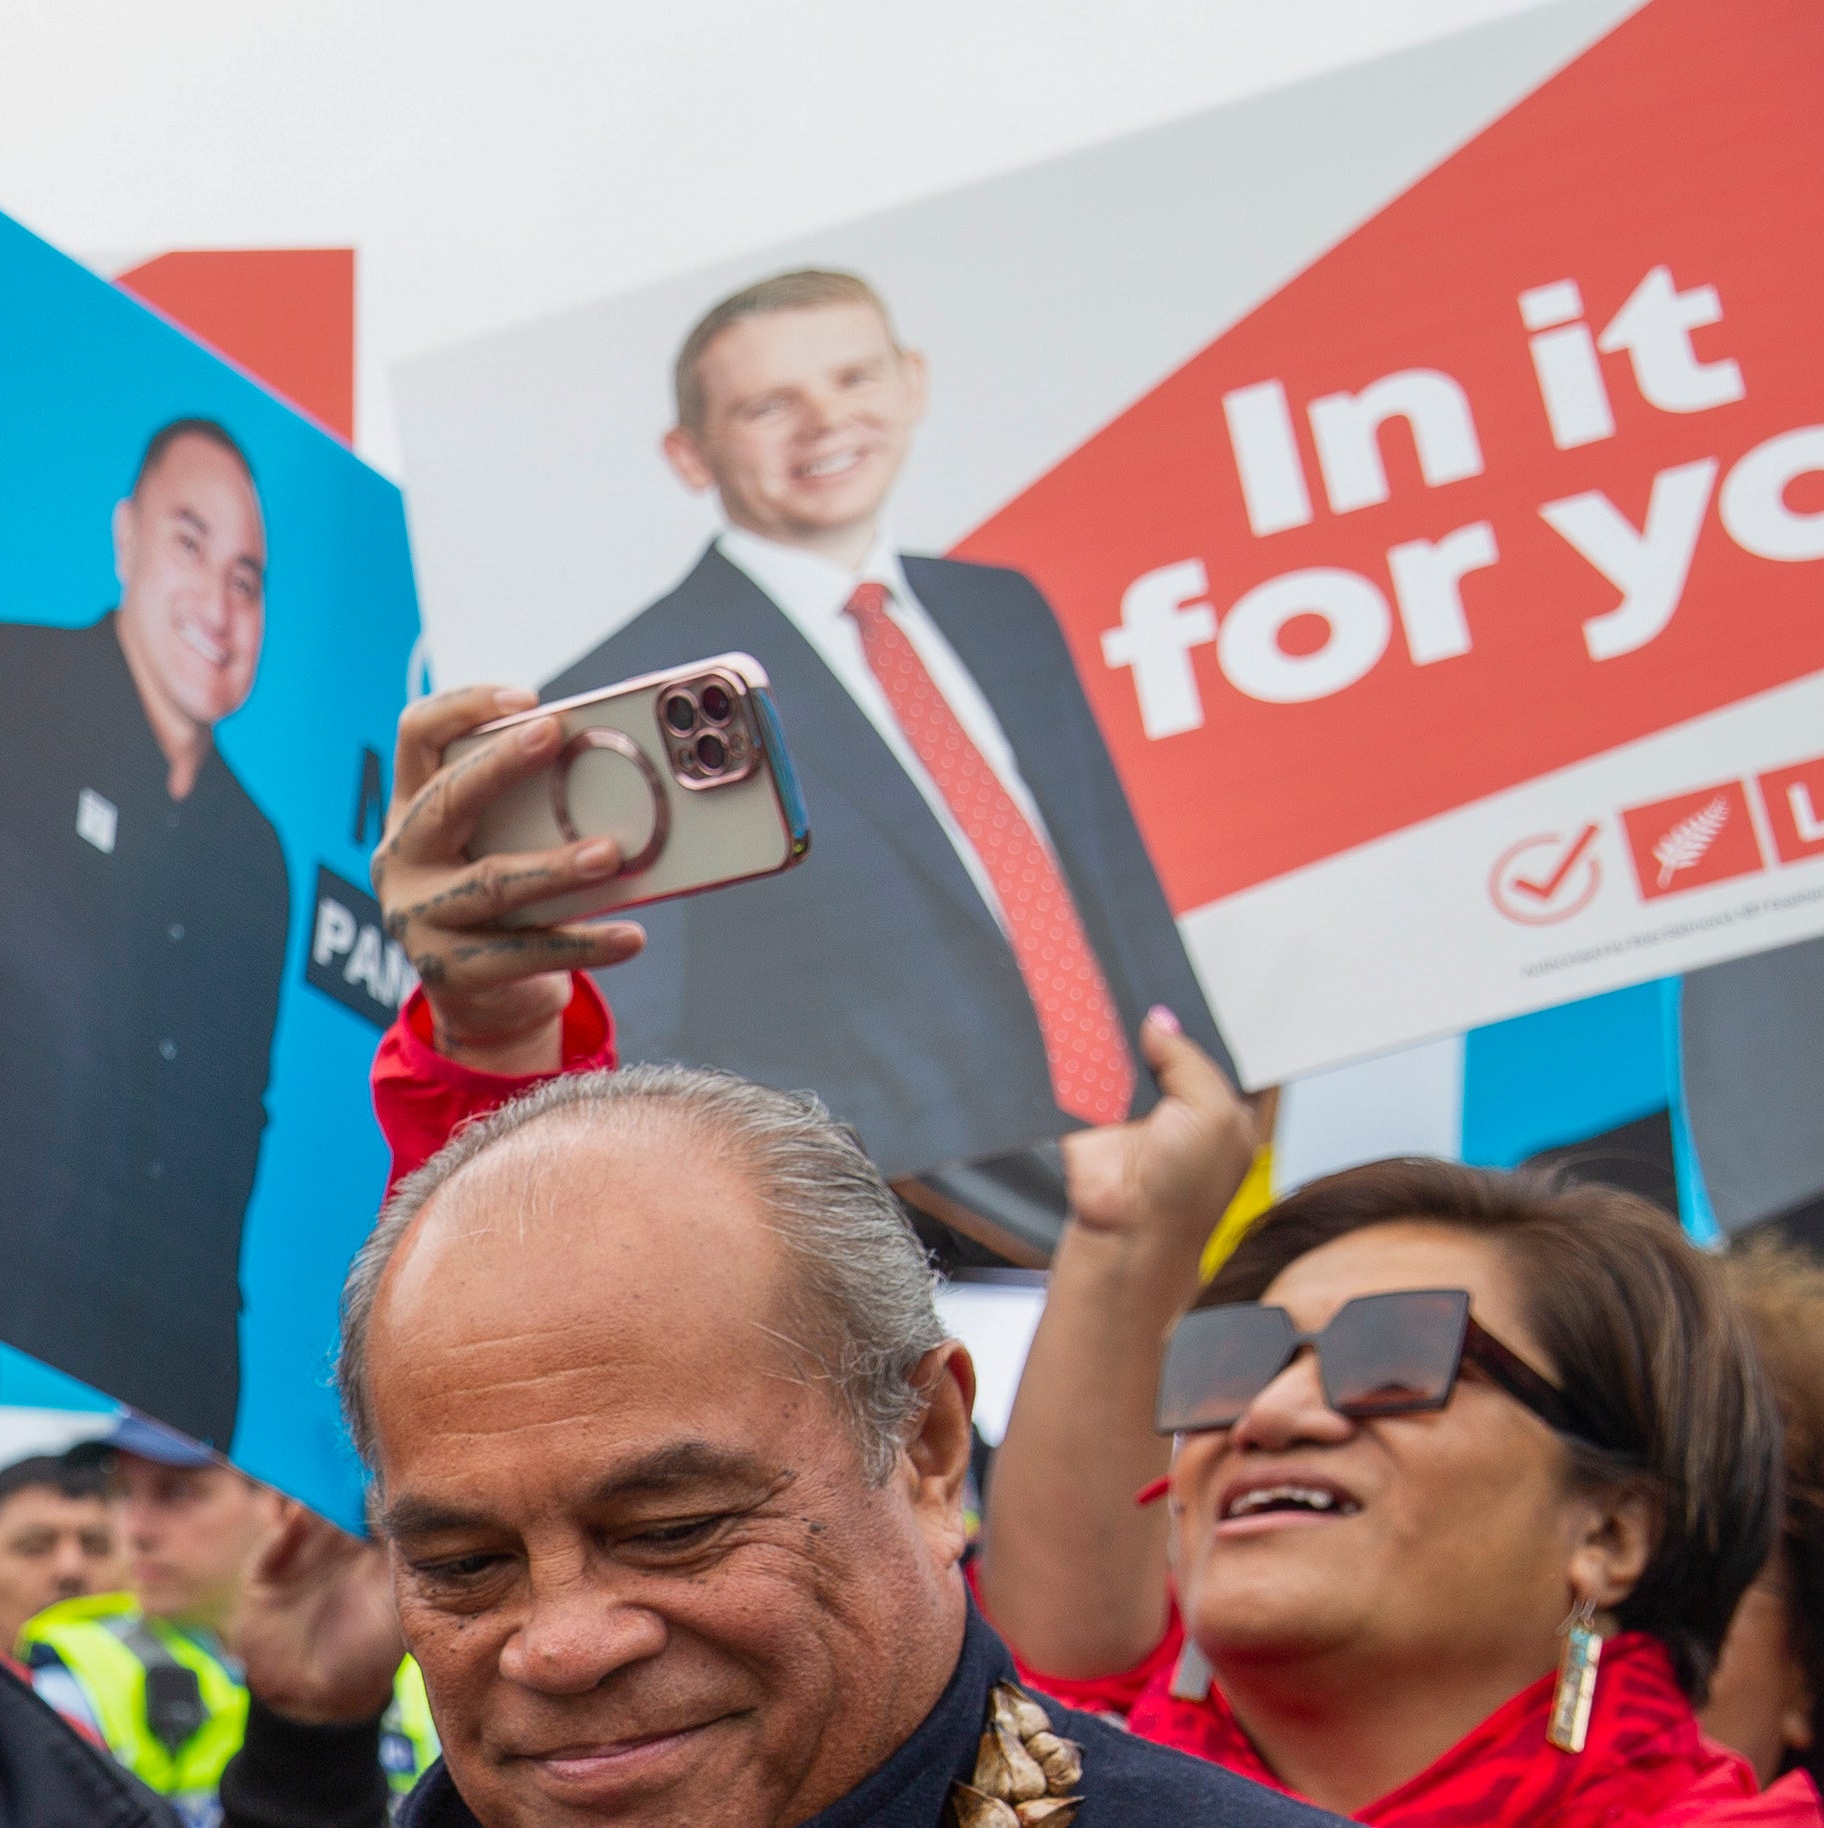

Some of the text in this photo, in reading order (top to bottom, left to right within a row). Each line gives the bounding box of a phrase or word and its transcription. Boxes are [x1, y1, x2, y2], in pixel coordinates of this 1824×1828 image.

[1222, 264, 1746, 537] In it
[1101, 520, 1499, 742] for
